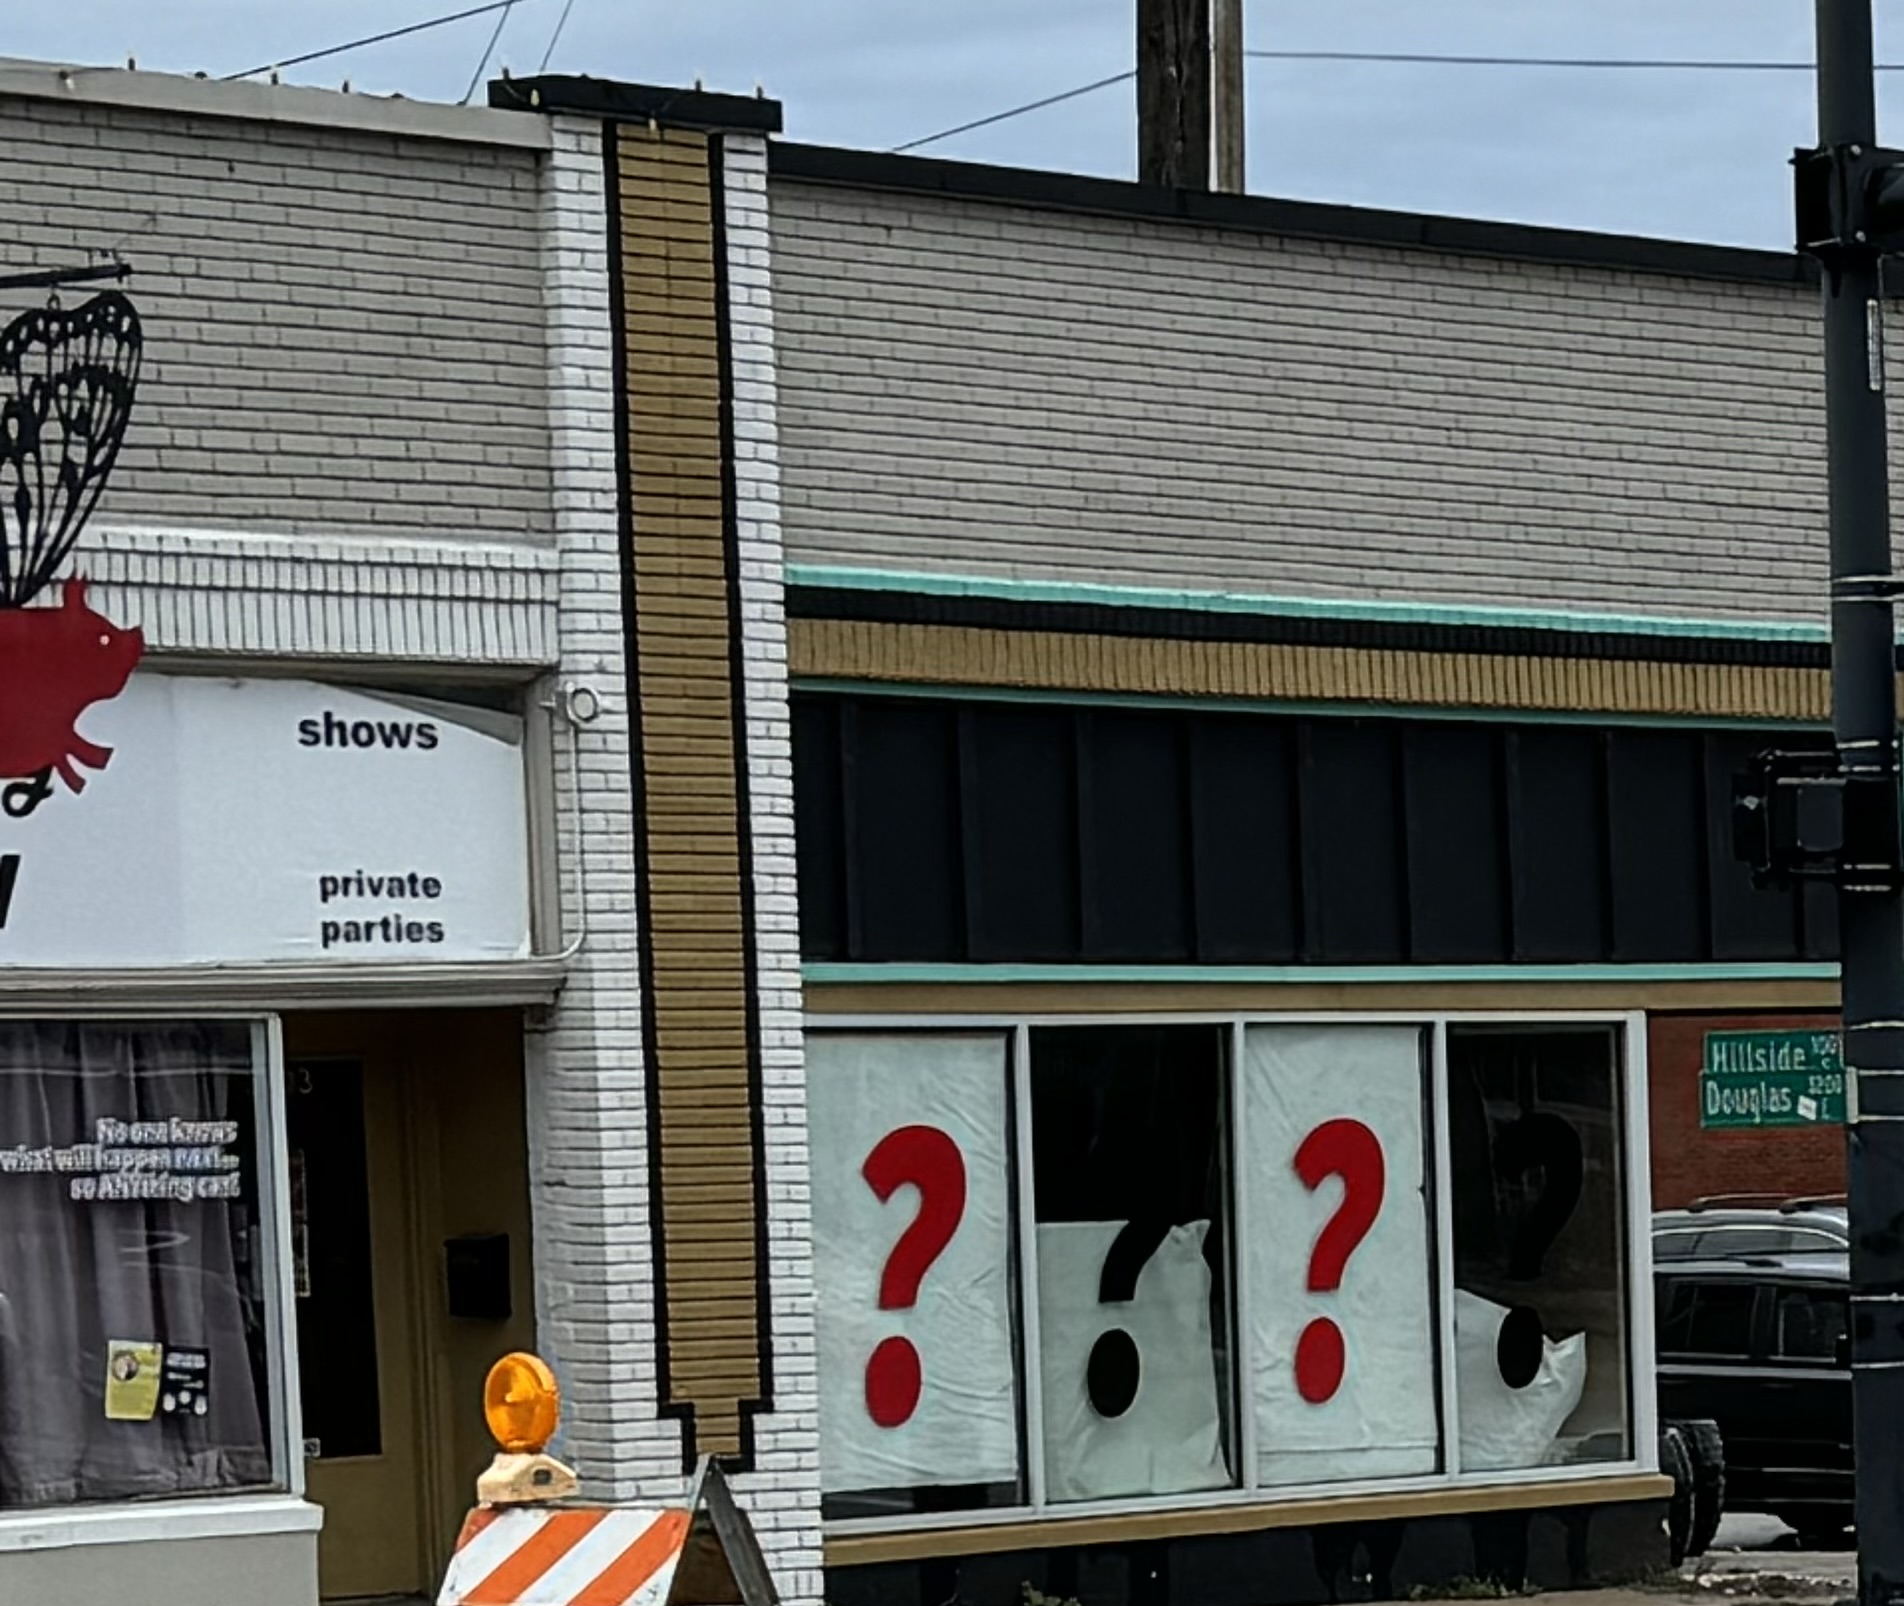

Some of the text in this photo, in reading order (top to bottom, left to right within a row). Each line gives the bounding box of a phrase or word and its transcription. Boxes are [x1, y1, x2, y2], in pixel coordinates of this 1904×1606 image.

[298, 710, 439, 750] shows
[319, 869, 442, 904] private
[321, 913, 445, 949] parties
[1712, 1040, 1805, 1072] Hillside
[1706, 1080, 1792, 1123] Douglas
